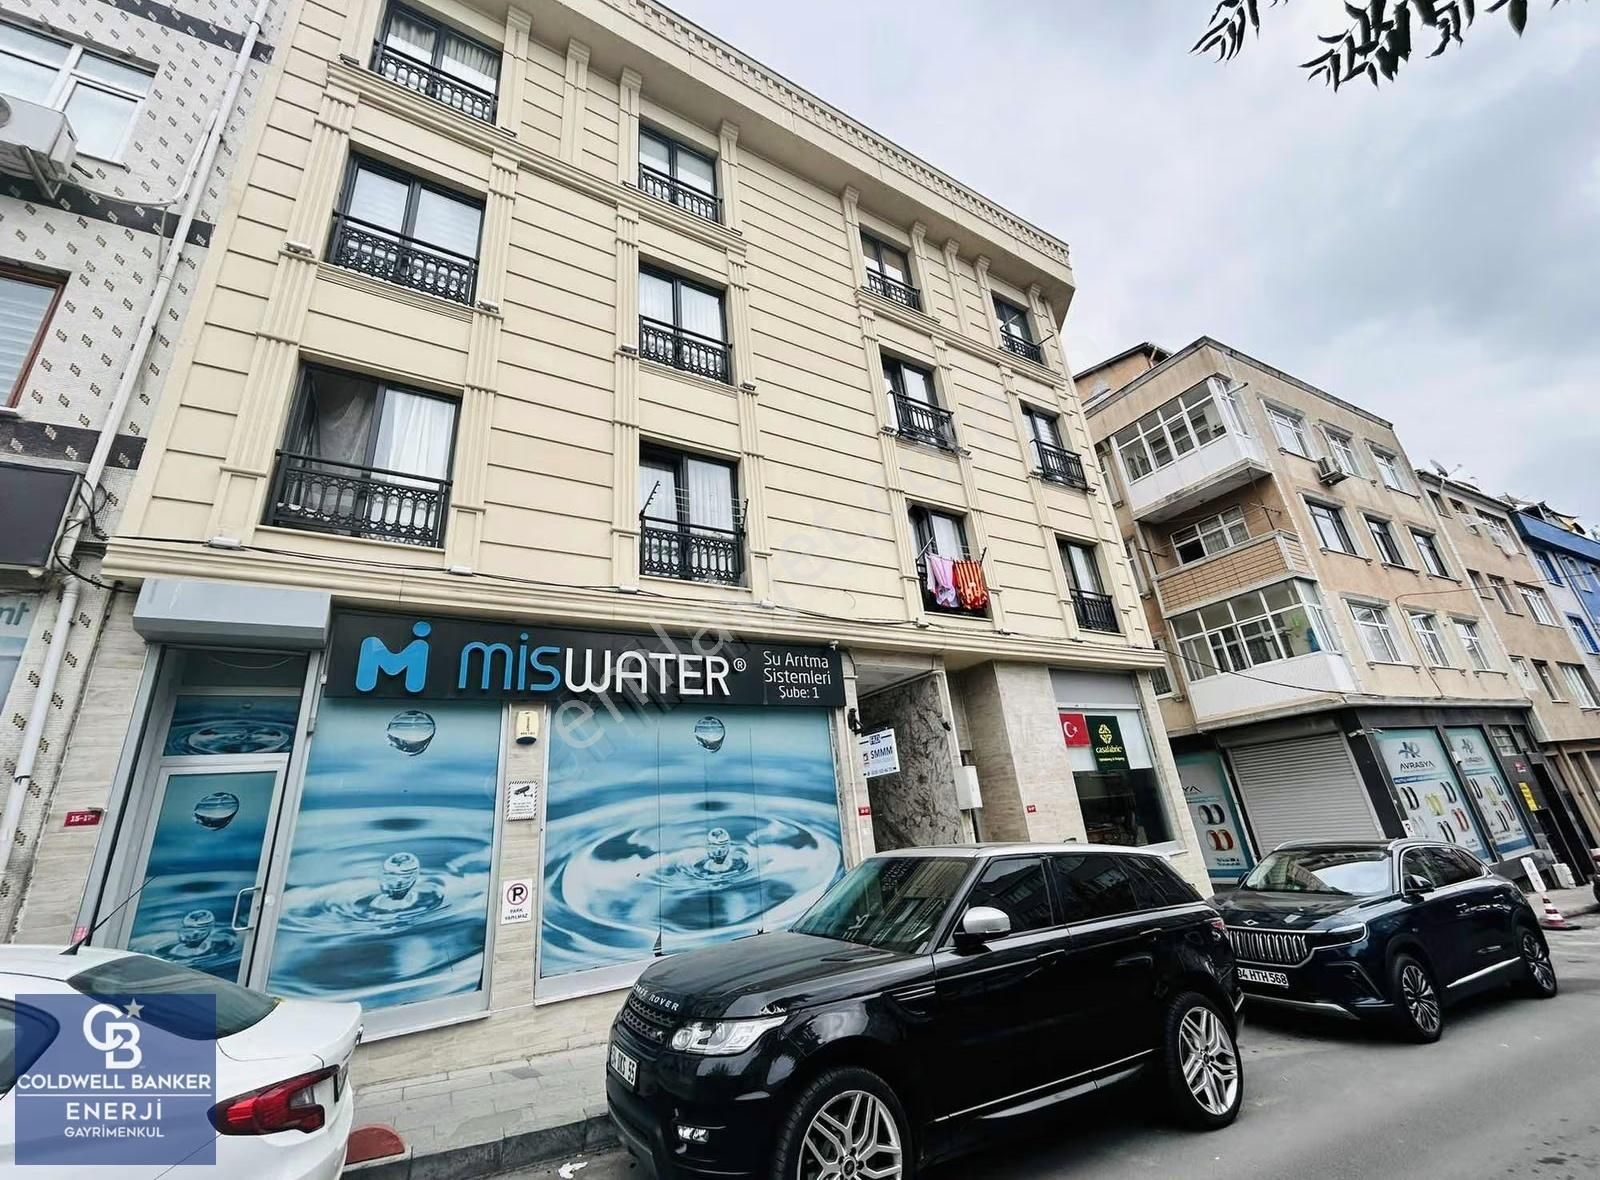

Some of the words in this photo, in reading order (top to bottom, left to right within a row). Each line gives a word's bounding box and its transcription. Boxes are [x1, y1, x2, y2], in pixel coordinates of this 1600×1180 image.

[763, 650, 781, 666] Su
[785, 652, 829, 669] Arıtma
[763, 667, 831, 685] Sistemleri
[778, 685, 810, 699] Şube:
[813, 686, 820, 698] 1
[1400, 760, 1436, 771] AVRASYA
[1249, 969, 1269, 982] HTH
[1268, 972, 1288, 985] 568
[648, 994, 680, 1011] ROVER
